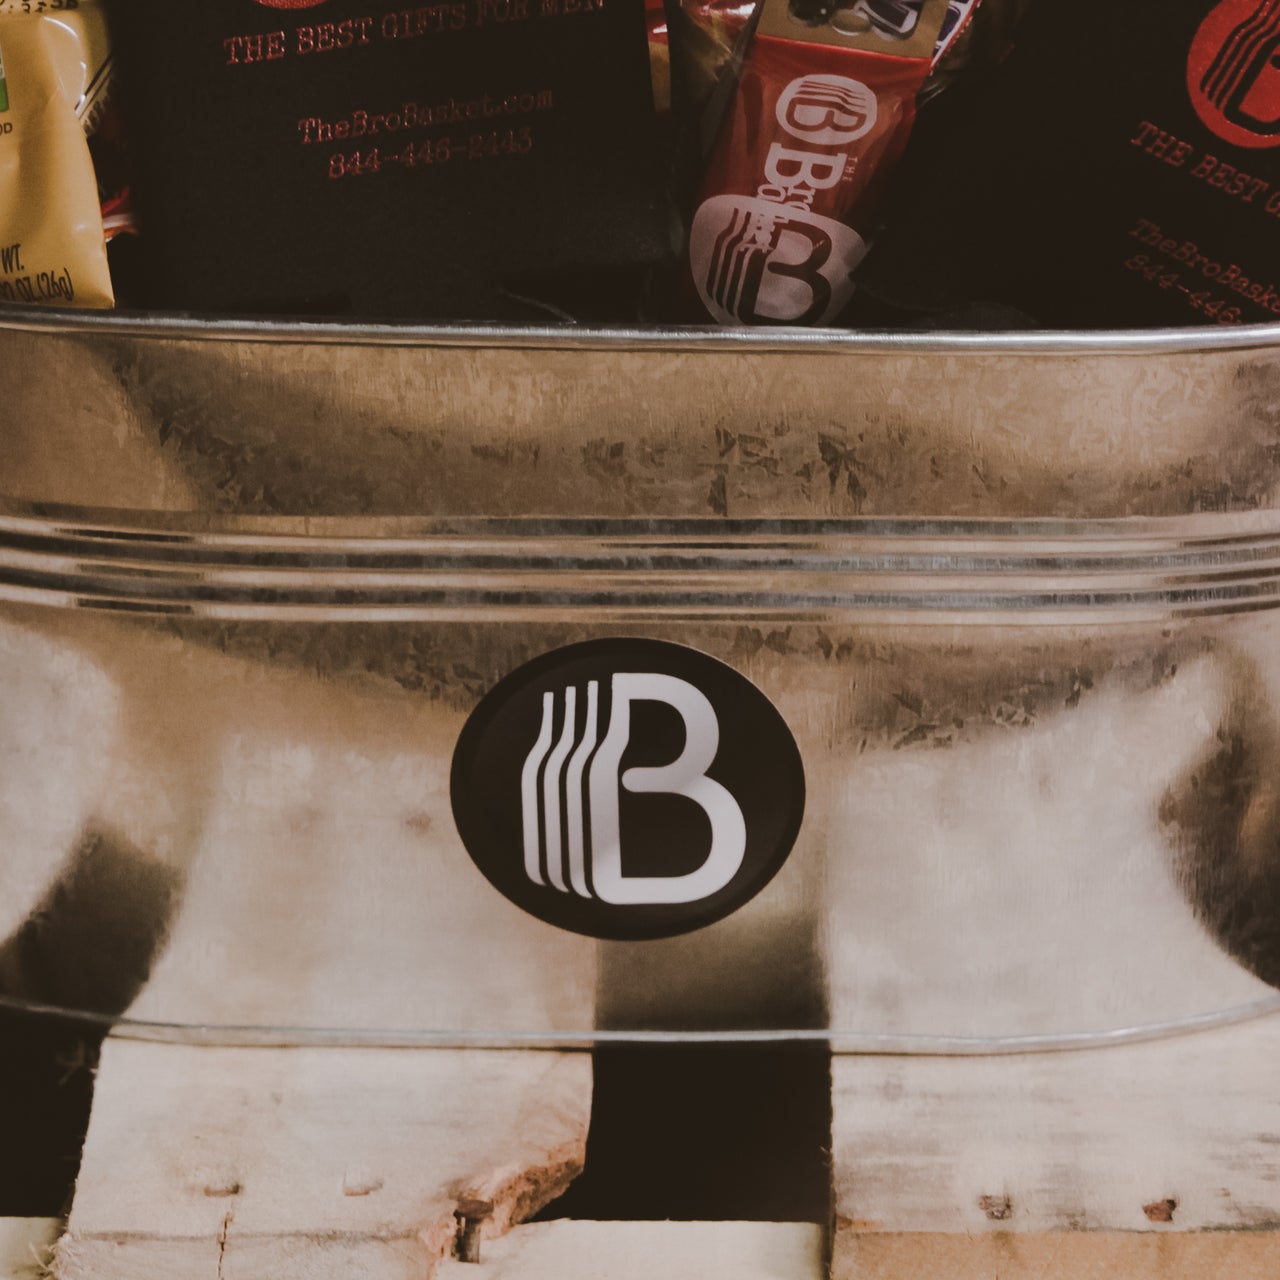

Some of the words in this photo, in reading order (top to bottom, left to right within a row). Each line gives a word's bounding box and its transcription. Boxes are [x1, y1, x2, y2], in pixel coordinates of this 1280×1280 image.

[223, 30, 286, 65] THE
[296, 17, 373, 55] BEST
[381, 2, 467, 40] GIFTS
[298, 89, 554, 145] TheBroBasket.com
[1131, 120, 1194, 168] THE
[1191, 153, 1269, 203] BEST
[1, 243, 25, 271] WT.
[517, 669, 750, 908] B
